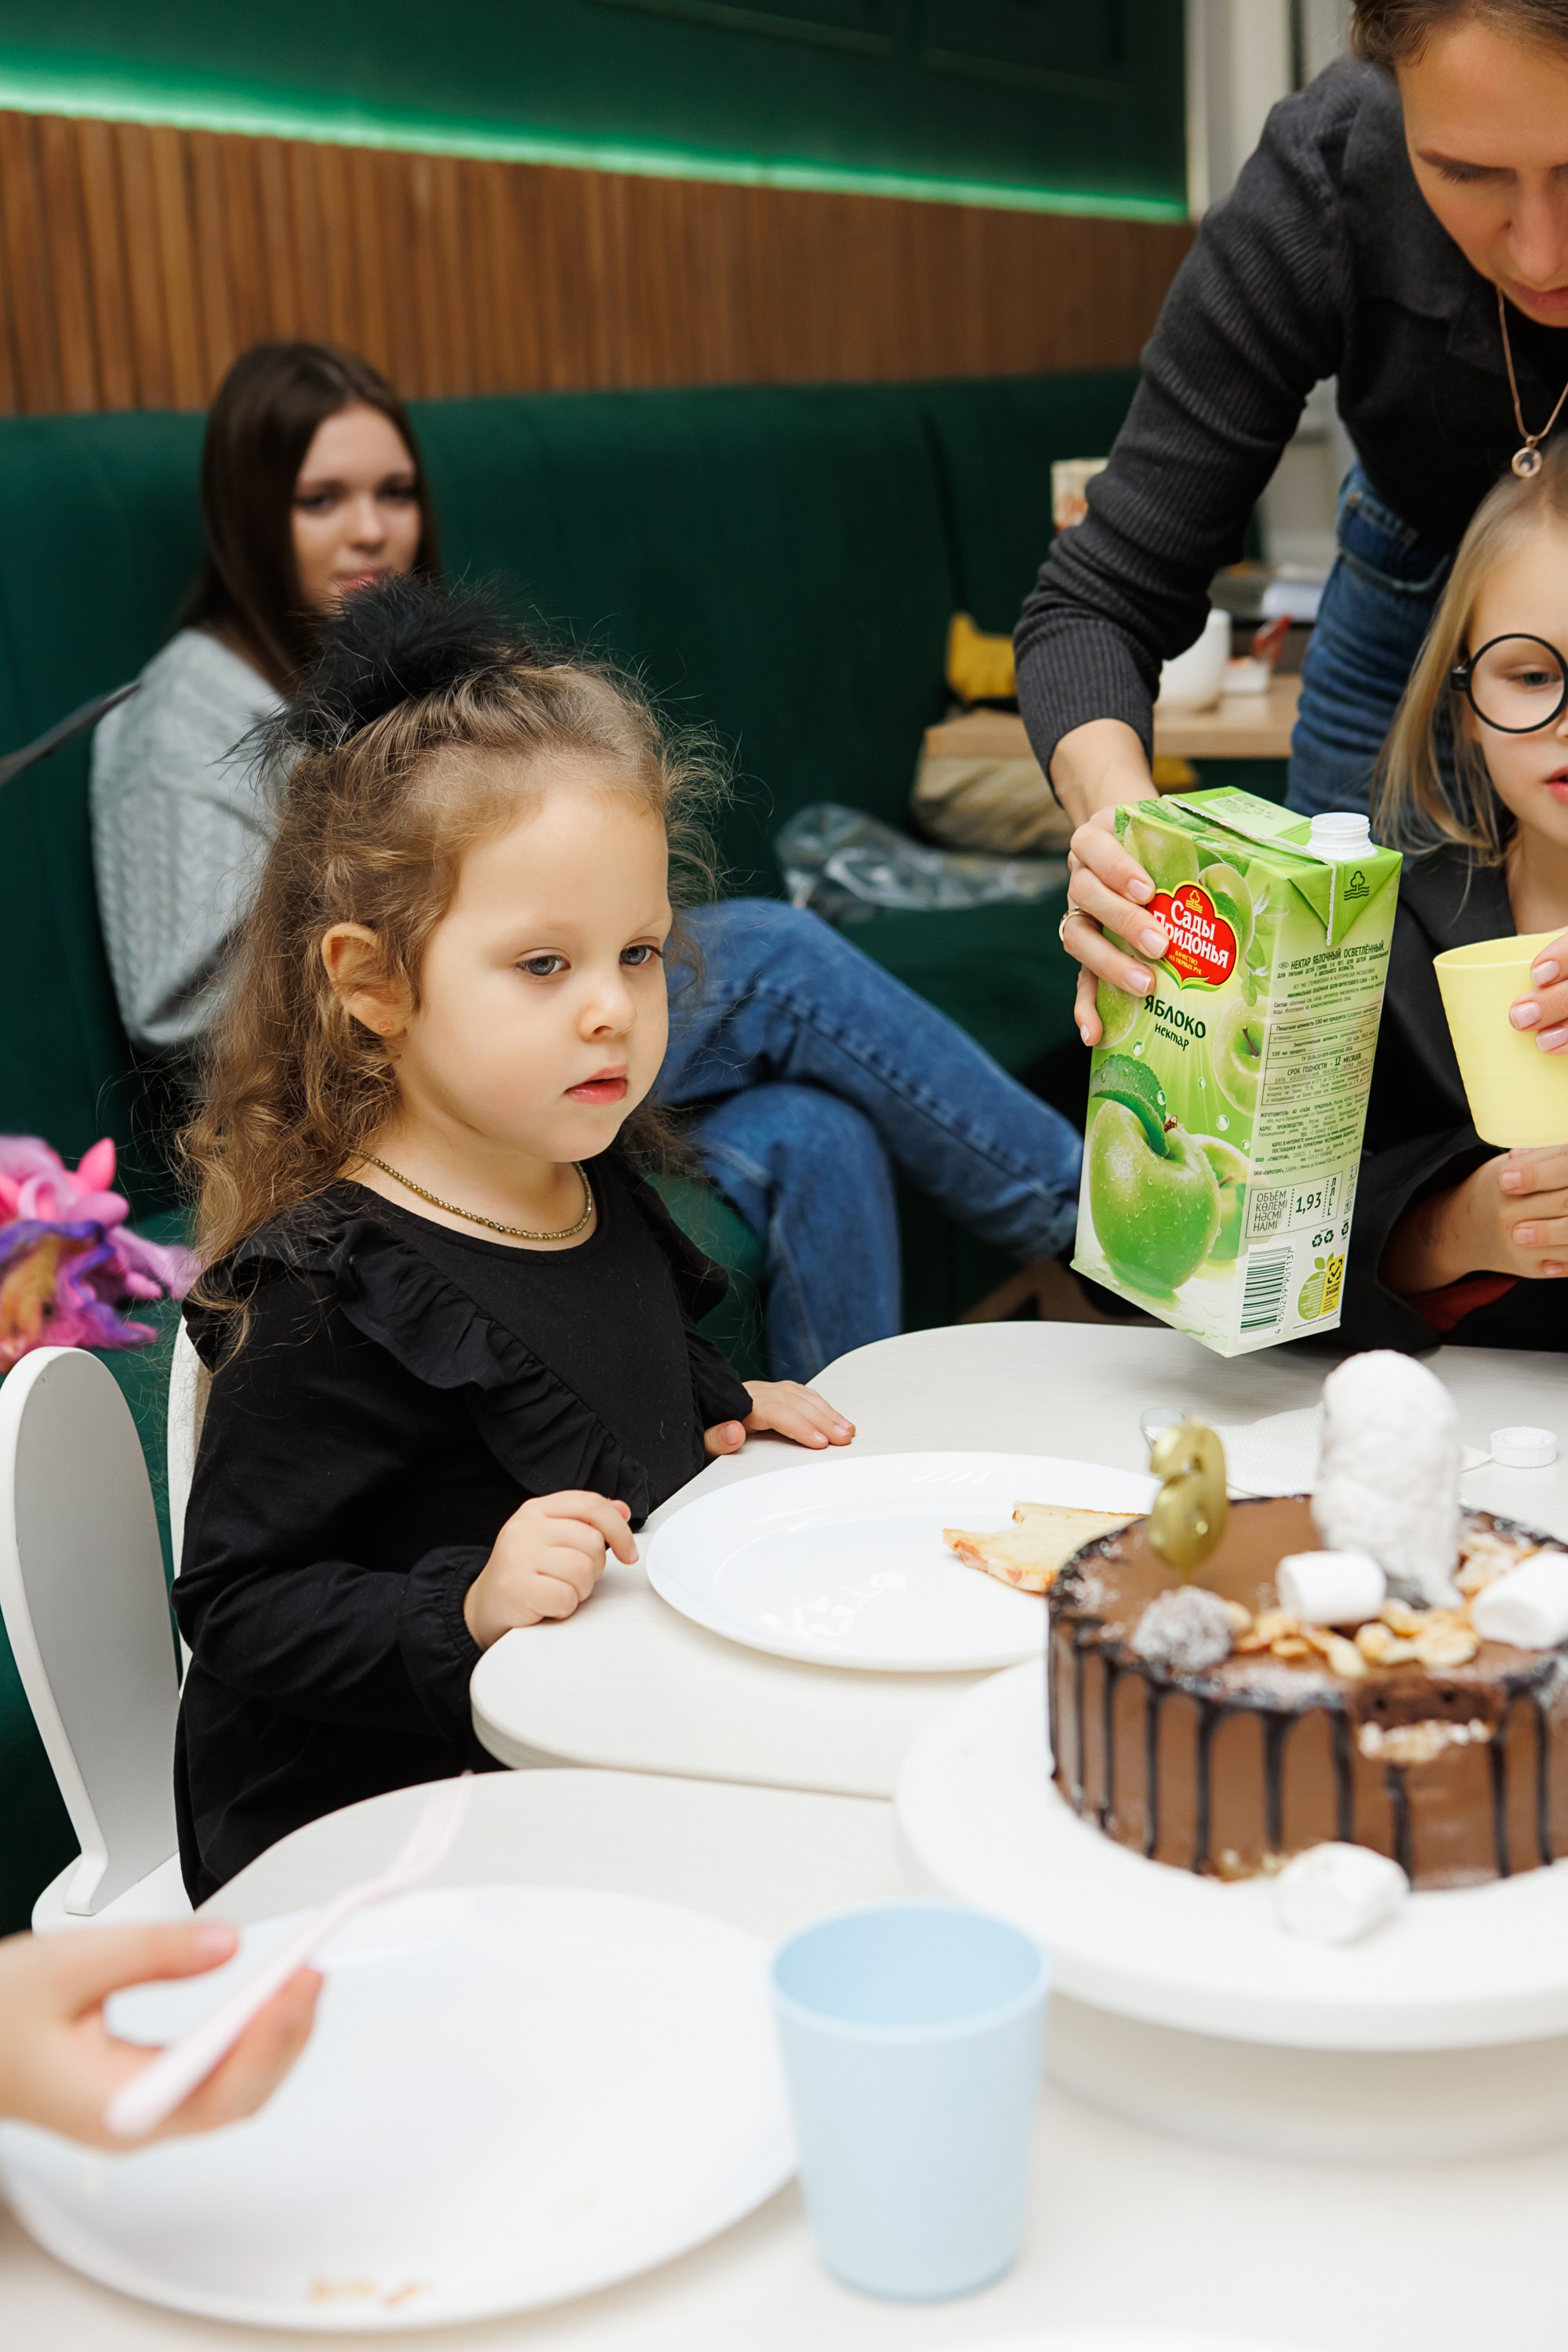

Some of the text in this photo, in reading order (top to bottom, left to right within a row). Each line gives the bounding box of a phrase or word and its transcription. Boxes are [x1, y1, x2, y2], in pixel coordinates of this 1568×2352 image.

[1171, 900, 1216, 941] Сады
[1174, 949, 1199, 965] КАЧЕСТВО
[1290, 957, 1311, 970] НЕКТАР
[1312, 949, 1341, 965] ЯБЛОЧНЫЙ
[1193, 964, 1202, 975] РУК
[1144, 994, 1206, 1038] ЯБЛОКО
[1155, 1022, 1189, 1052] нектар
[1287, 1067, 1301, 1076] СРОК
[1302, 1062, 1327, 1073] ГОДНОСТИ
[1334, 1057, 1341, 1066] 12
[1257, 1190, 1322, 1214] ОБЪЁМ 1,93
[1277, 1289, 1288, 1322] 650259
[1283, 1249, 1294, 1284] 901137
